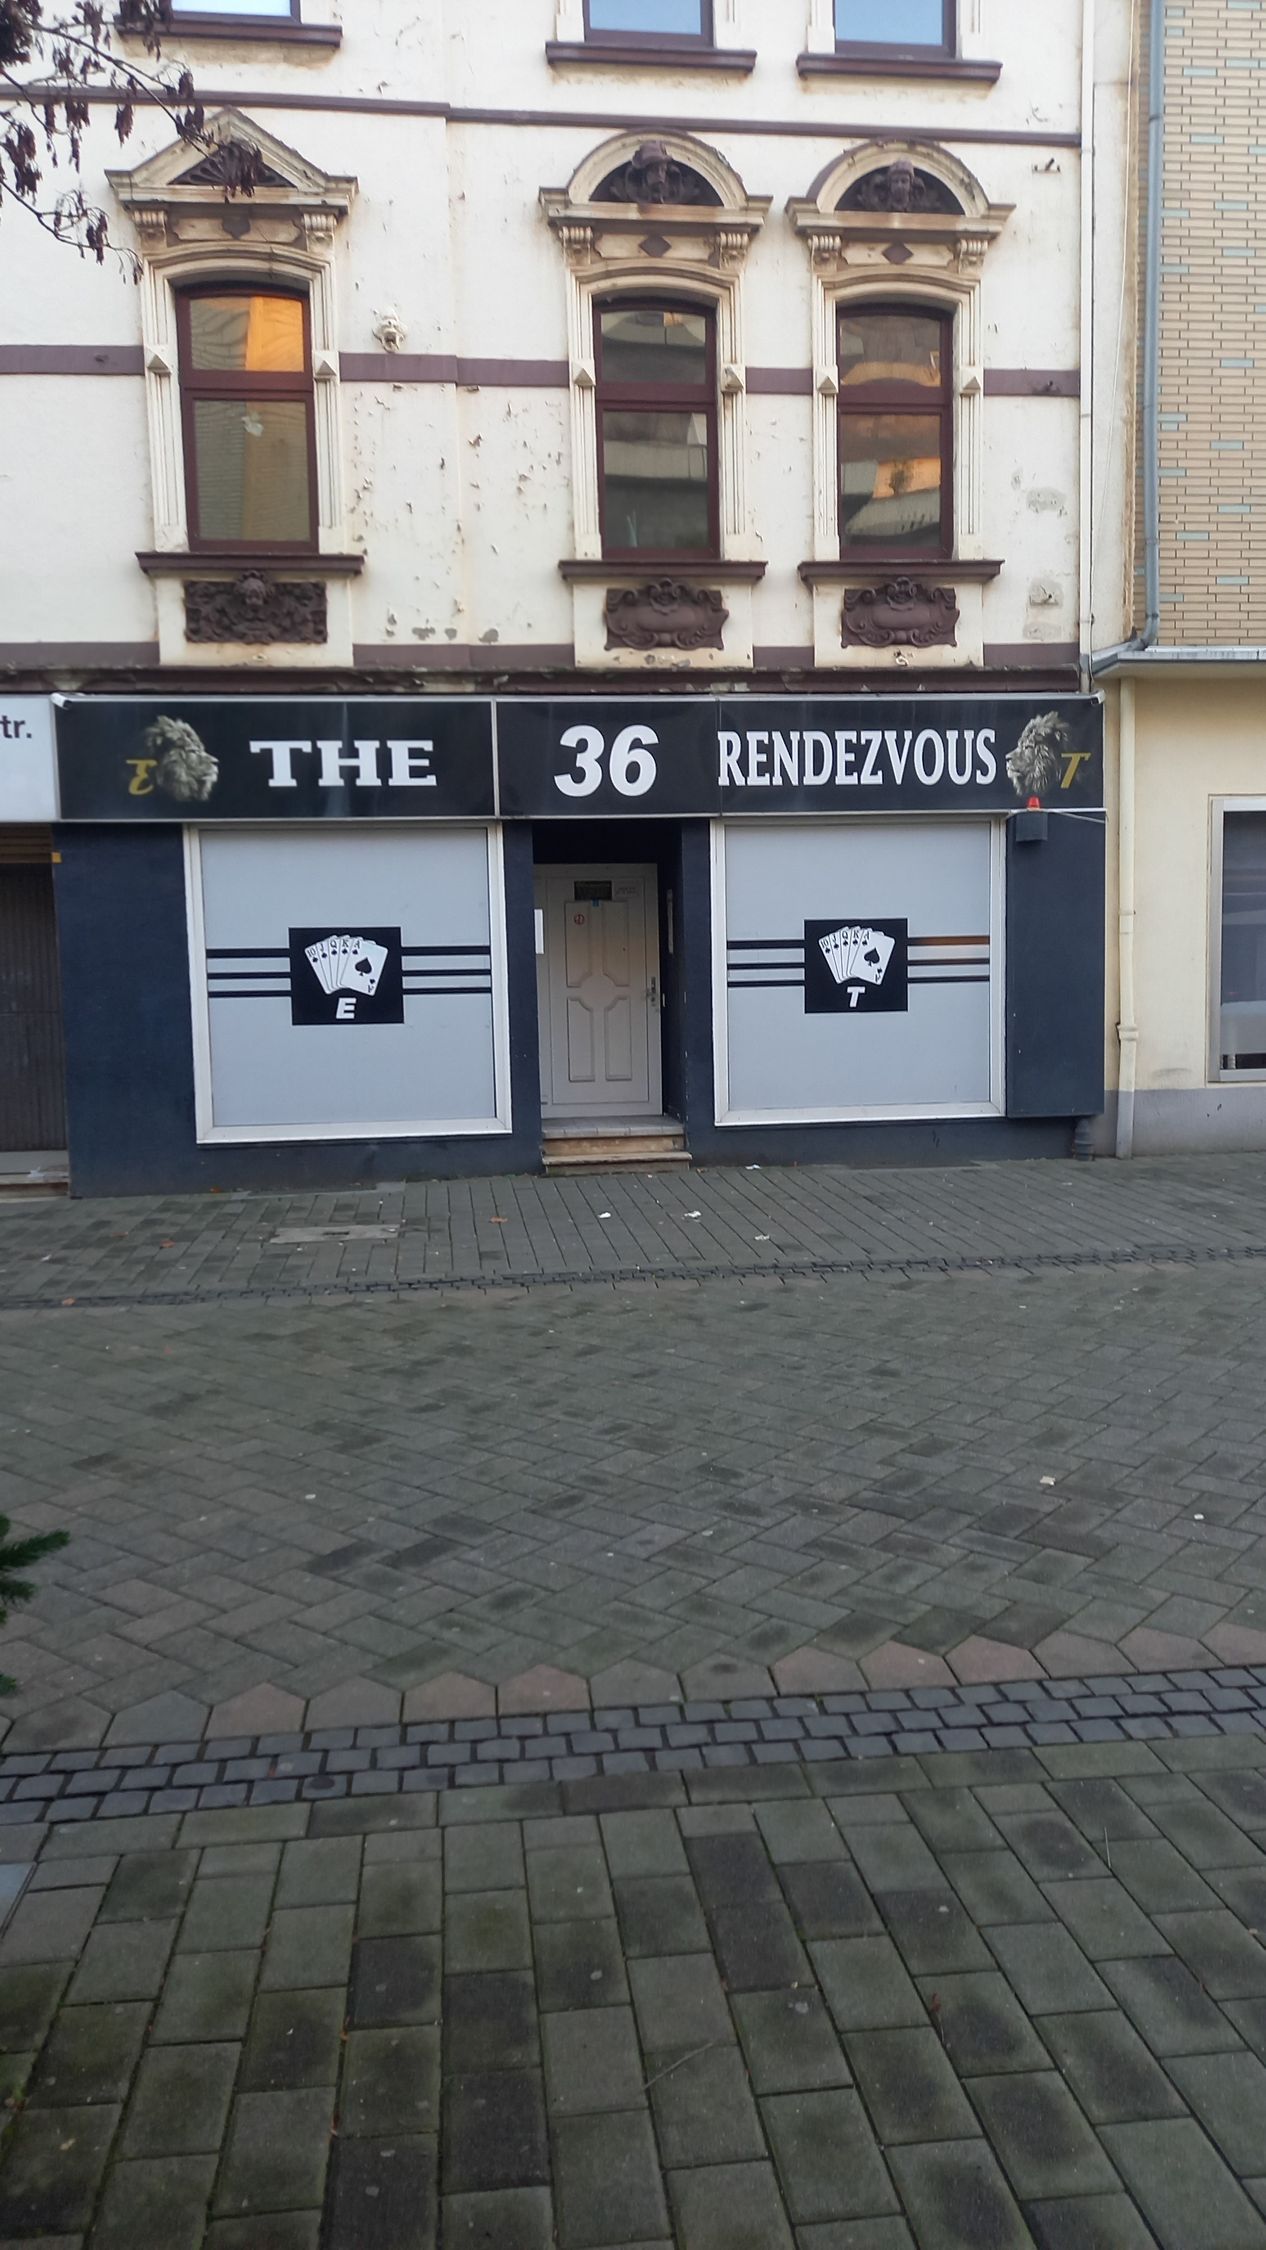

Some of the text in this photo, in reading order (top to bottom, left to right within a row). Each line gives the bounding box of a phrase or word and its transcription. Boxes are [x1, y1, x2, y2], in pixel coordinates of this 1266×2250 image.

[249, 724, 997, 797] THE 36 RENDEZVOUS
[1060, 752, 1092, 789] T
[306, 947, 316, 958] 10
[329, 939, 338, 949] Q
[341, 939, 350, 948] K
[335, 997, 357, 1019] E
[846, 986, 866, 1008] T
